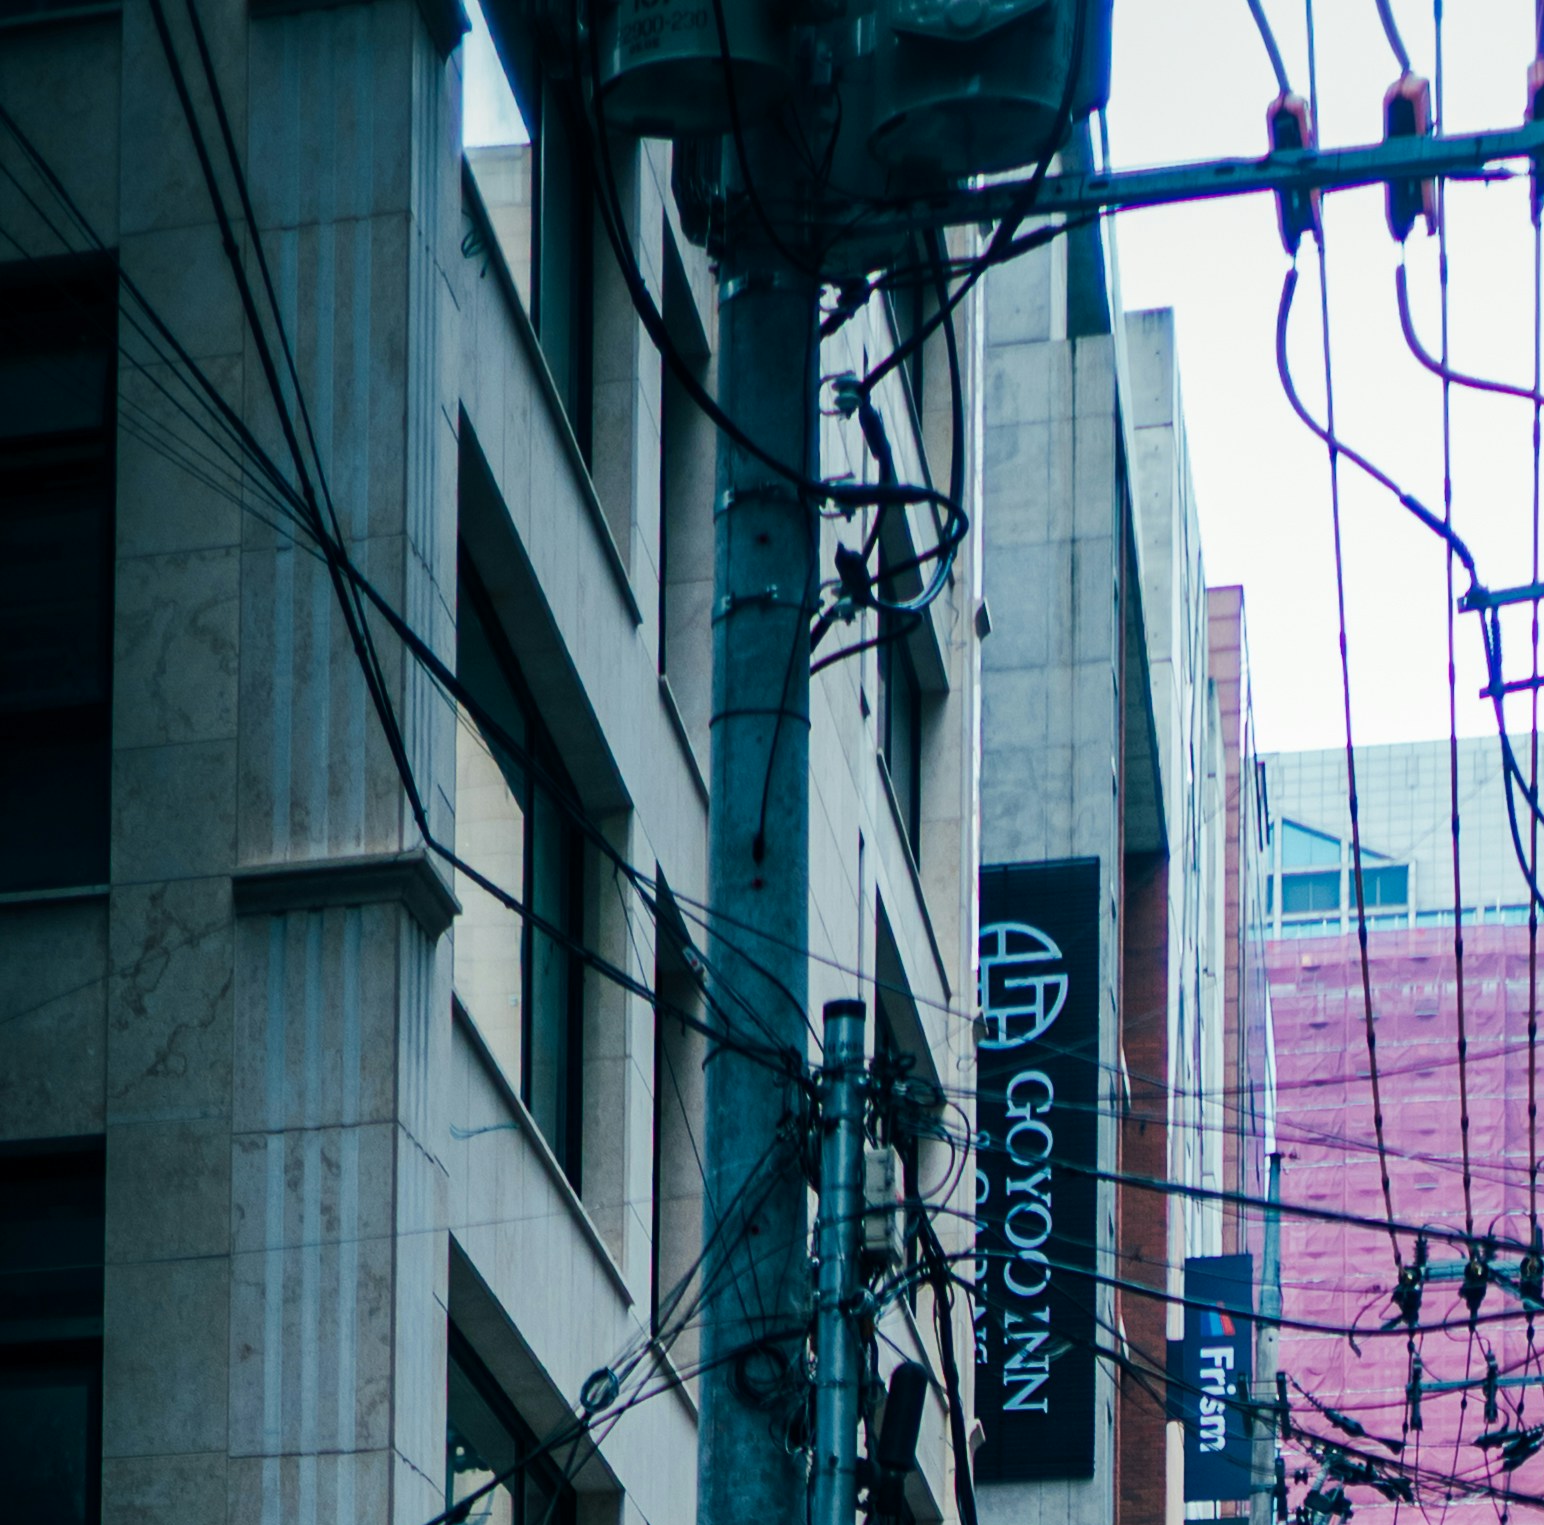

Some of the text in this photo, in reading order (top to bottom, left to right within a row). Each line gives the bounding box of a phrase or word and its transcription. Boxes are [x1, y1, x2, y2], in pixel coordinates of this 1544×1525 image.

[1003, 1071, 1054, 1414] GOYOO INN
[1200, 1347, 1236, 1452] Frism
